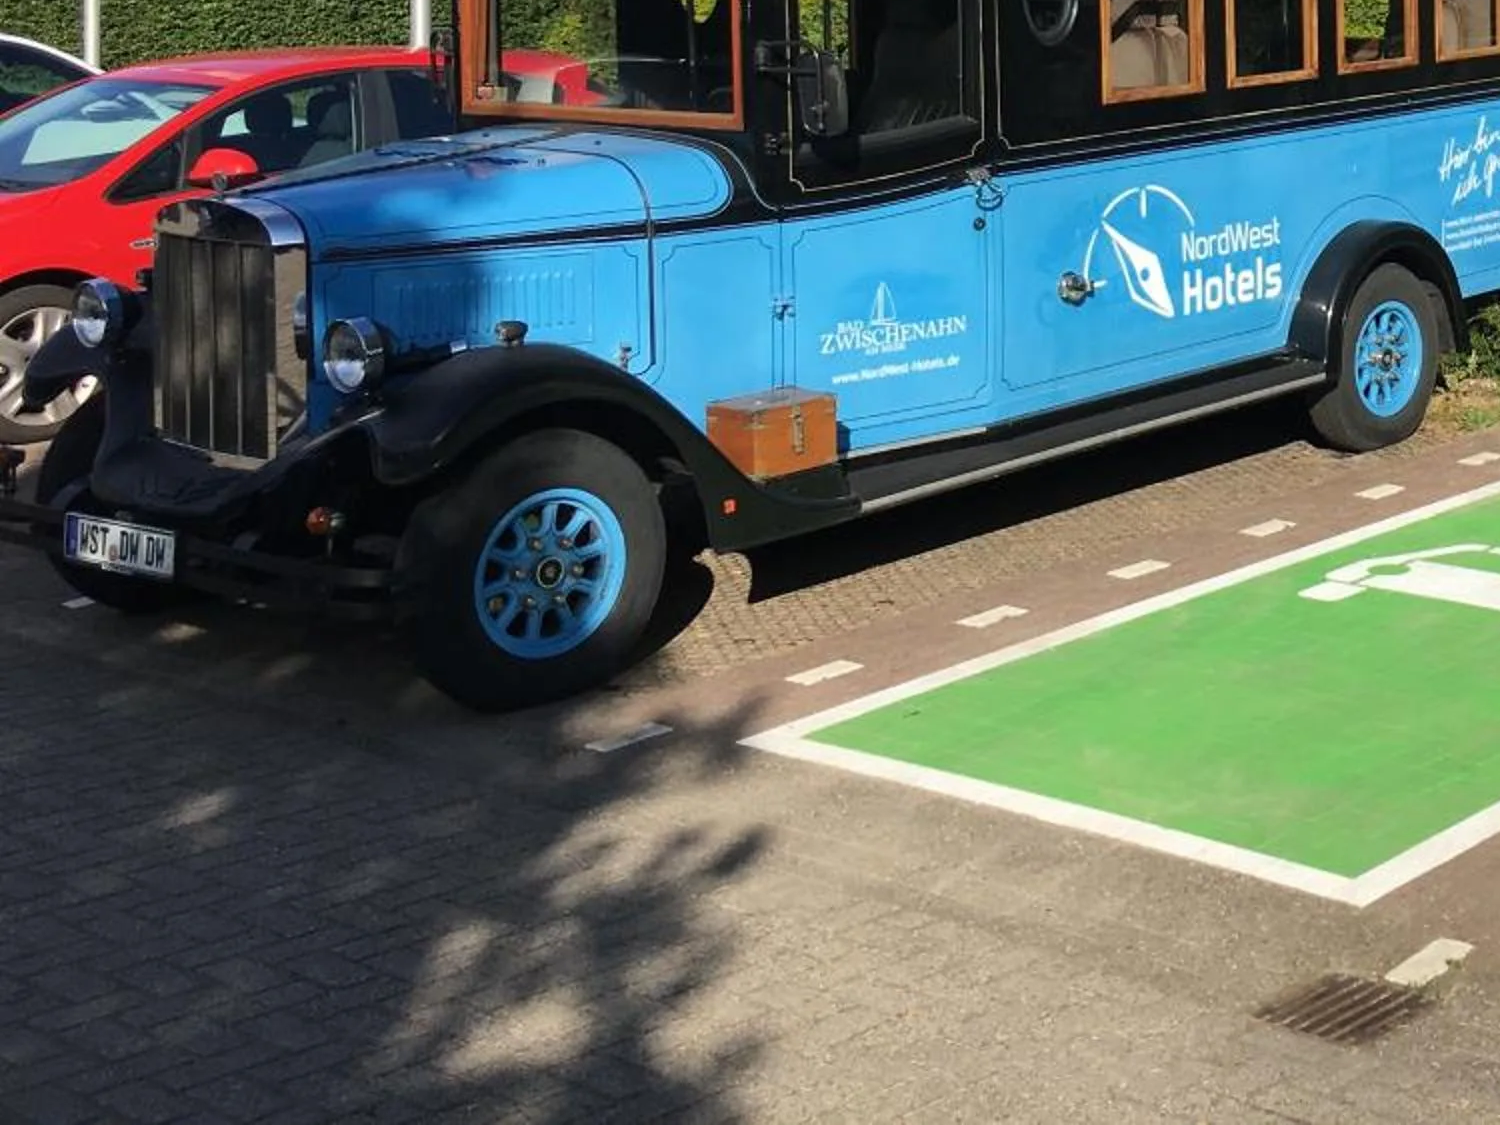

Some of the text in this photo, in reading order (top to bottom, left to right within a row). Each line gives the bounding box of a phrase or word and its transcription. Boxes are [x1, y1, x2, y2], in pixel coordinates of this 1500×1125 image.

[1181, 215, 1281, 262] NordWest
[1183, 256, 1282, 316] Hotels
[820, 315, 967, 355] ZWISCHENAHN
[79, 522, 110, 556] WST
[119, 530, 141, 564] DW
